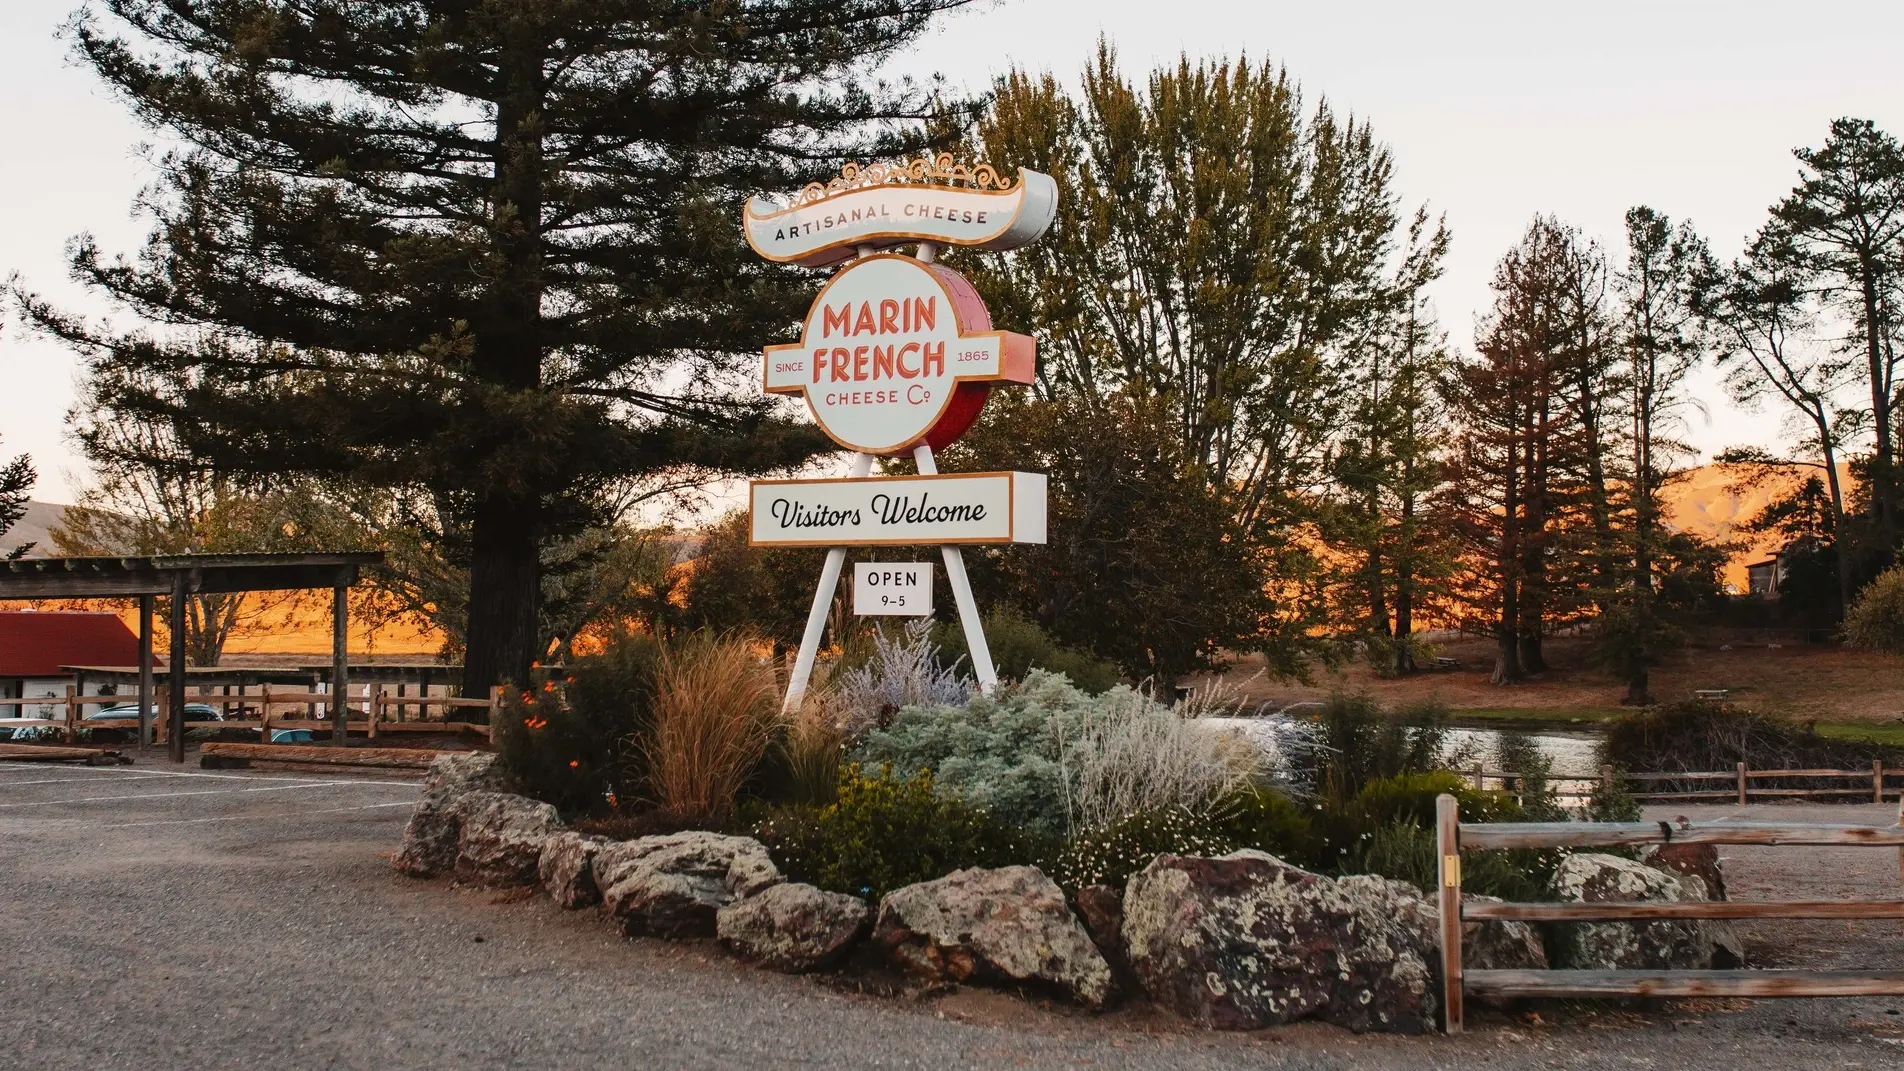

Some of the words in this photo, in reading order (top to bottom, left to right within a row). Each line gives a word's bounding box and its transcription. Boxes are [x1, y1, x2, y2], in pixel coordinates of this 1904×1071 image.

[774, 203, 890, 242] ARTISANAL
[903, 203, 988, 225] CHEESE
[822, 295, 936, 339] MARIN
[775, 361, 804, 373] SINCE
[812, 340, 945, 384] FRENCH
[957, 350, 989, 362] 1865
[825, 389, 898, 406] CHEESE
[771, 498, 861, 529] Visitors
[870, 492, 988, 525] Welcome
[867, 571, 918, 587] OPEN
